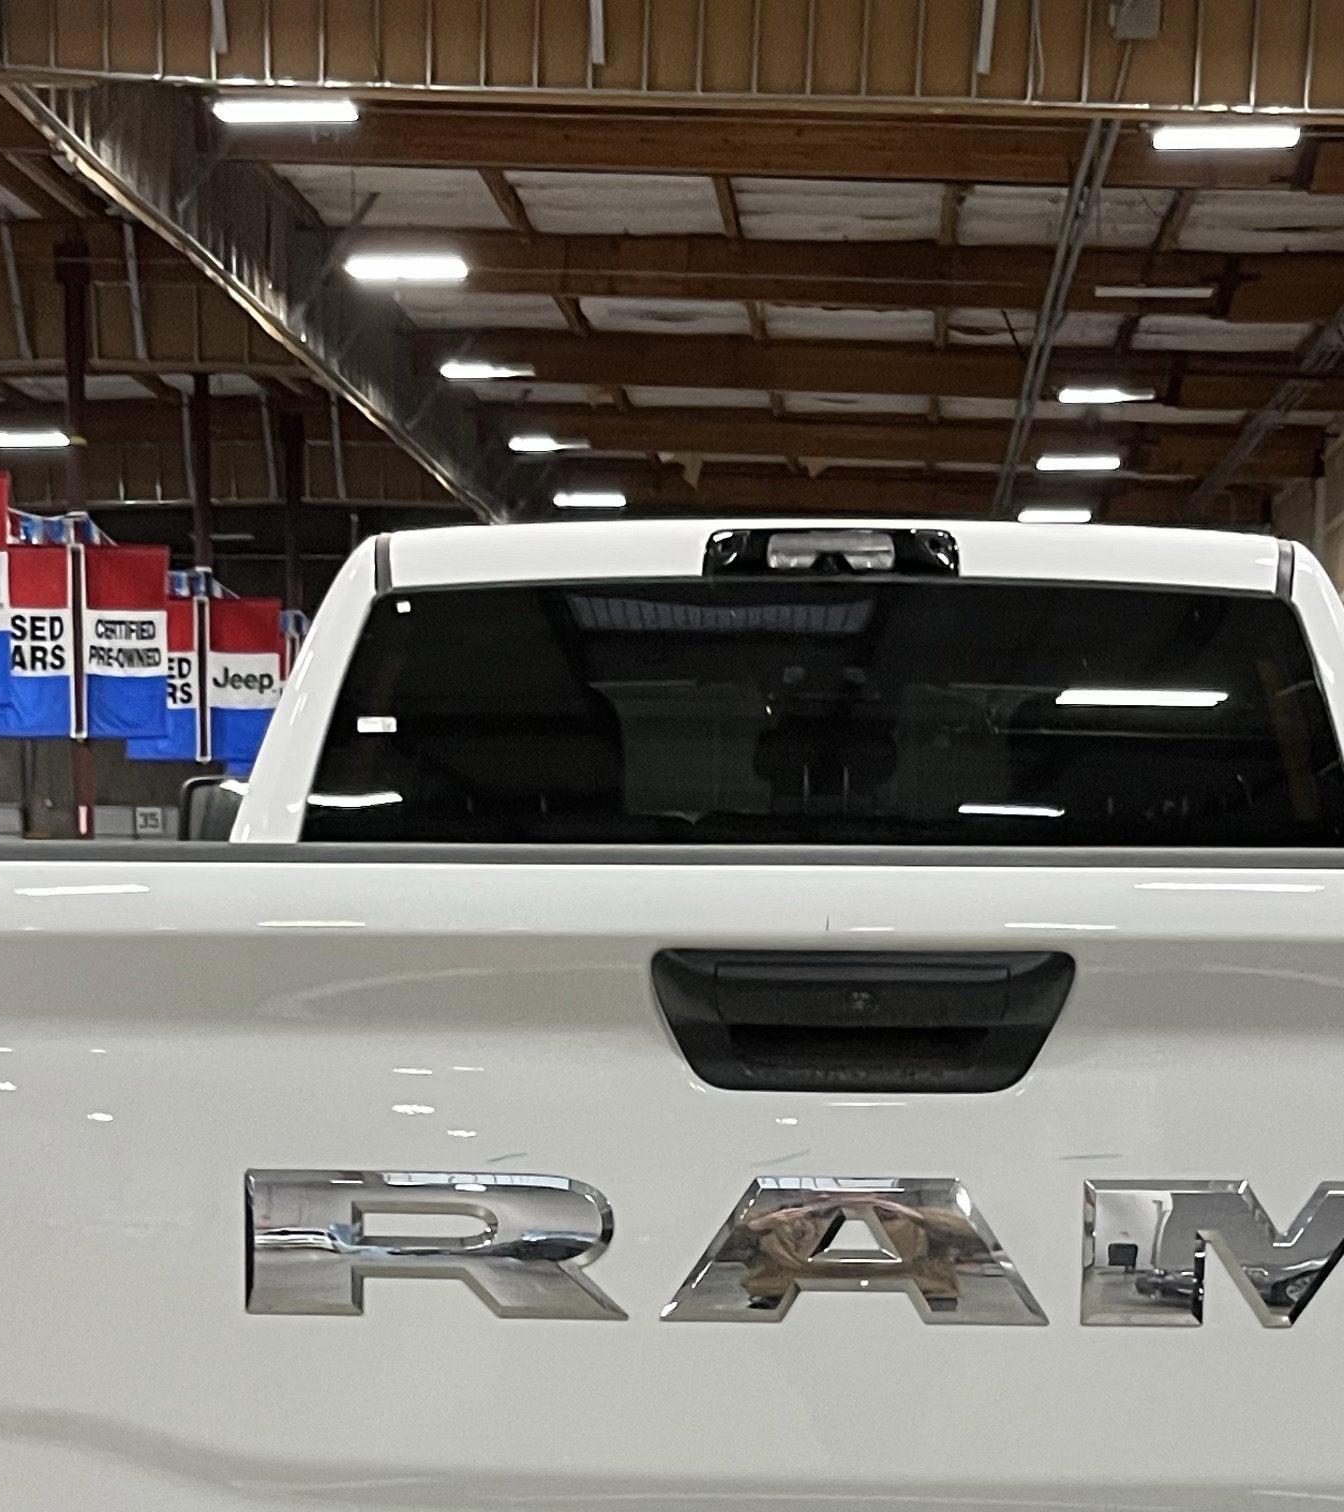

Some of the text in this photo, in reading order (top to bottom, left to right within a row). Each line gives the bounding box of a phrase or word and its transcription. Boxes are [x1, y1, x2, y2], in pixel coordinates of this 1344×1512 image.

[10, 614, 64, 641] SED
[11, 644, 66, 671] ARS
[167, 681, 193, 704] RS
[212, 667, 274, 694] Jeep
[139, 812, 159, 829] 35
